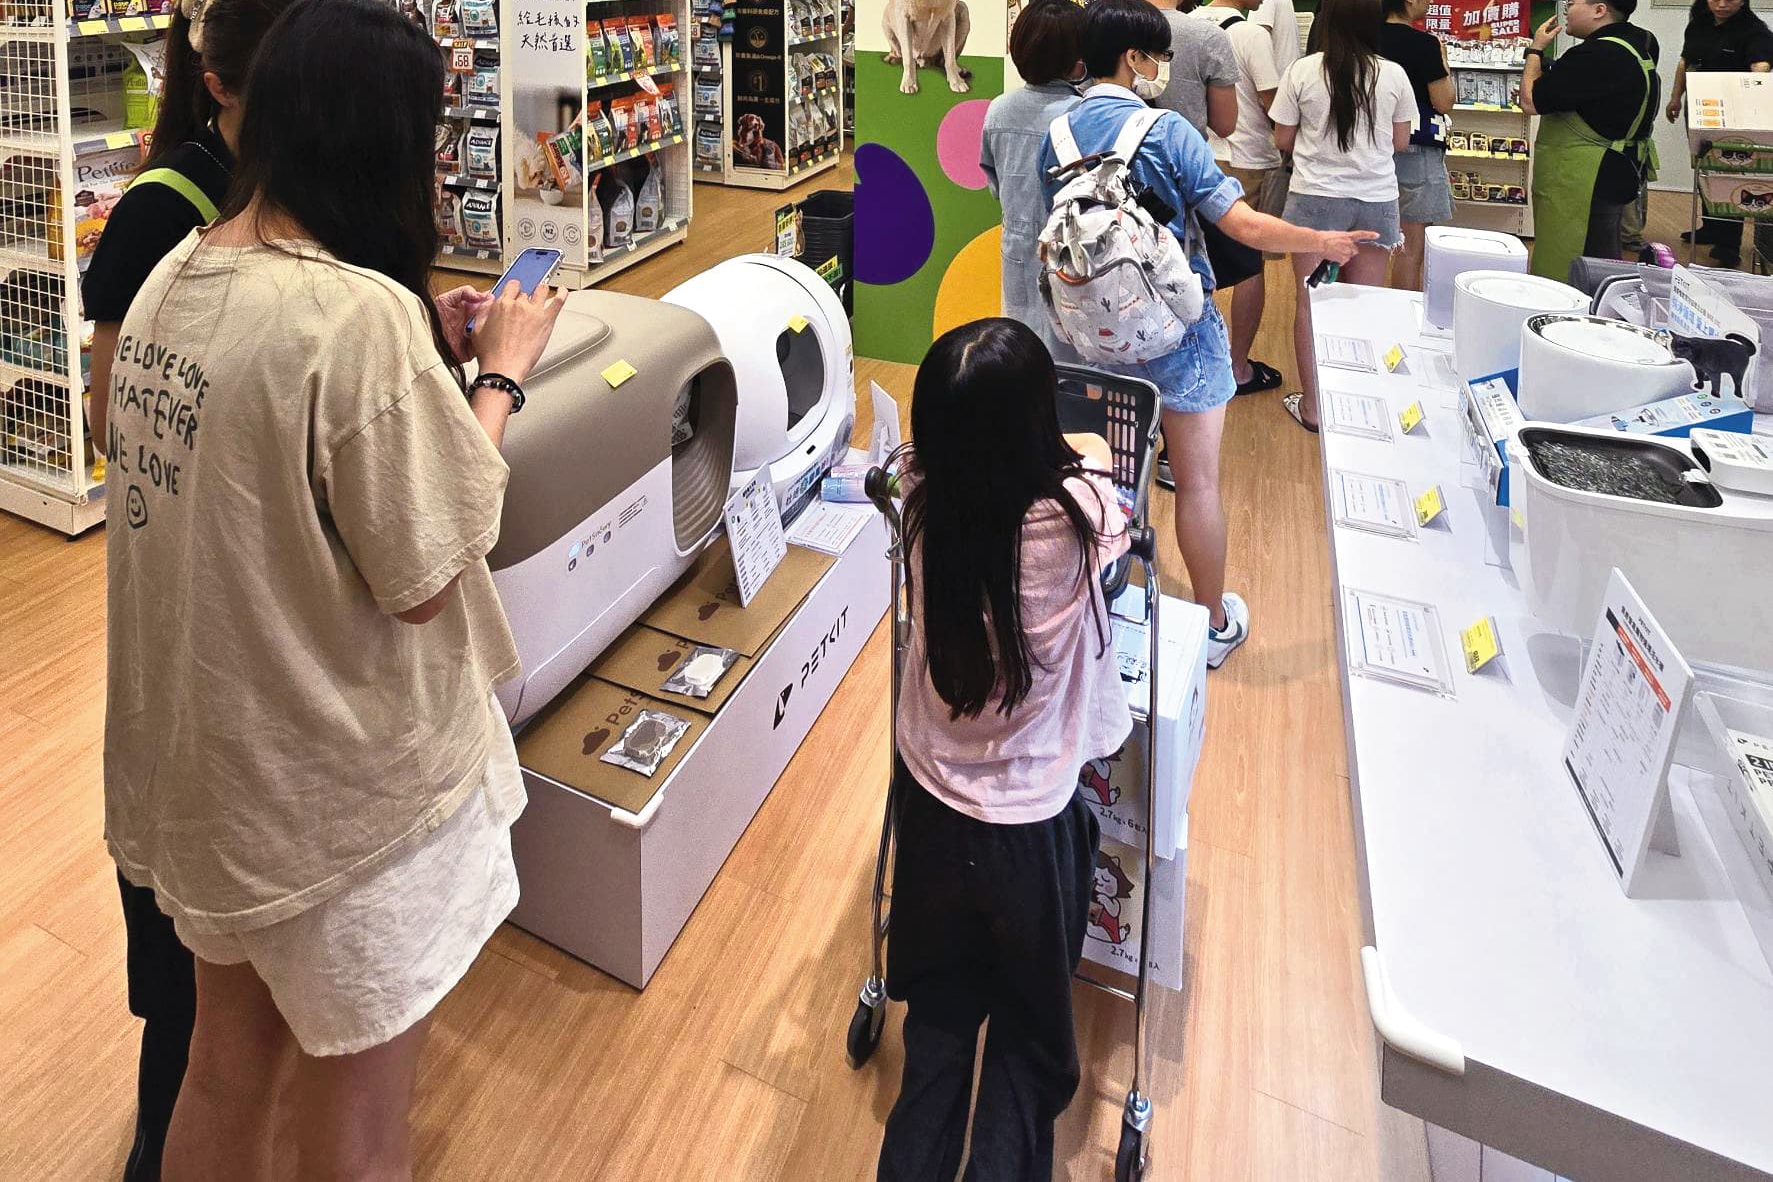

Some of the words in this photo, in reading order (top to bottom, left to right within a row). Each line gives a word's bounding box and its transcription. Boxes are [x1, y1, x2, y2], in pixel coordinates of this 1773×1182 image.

[1426, 4, 1452, 16] 超值
[1463, 1, 1520, 27] 加價購
[1425, 18, 1452, 31] 限量
[1490, 20, 1520, 29] SUPER
[1491, 27, 1520, 36] SALE
[521, 32, 577, 52] 天然首選
[133, 340, 177, 380] LOVE
[177, 357, 210, 409] LOVE
[138, 445, 181, 496] LOVE
